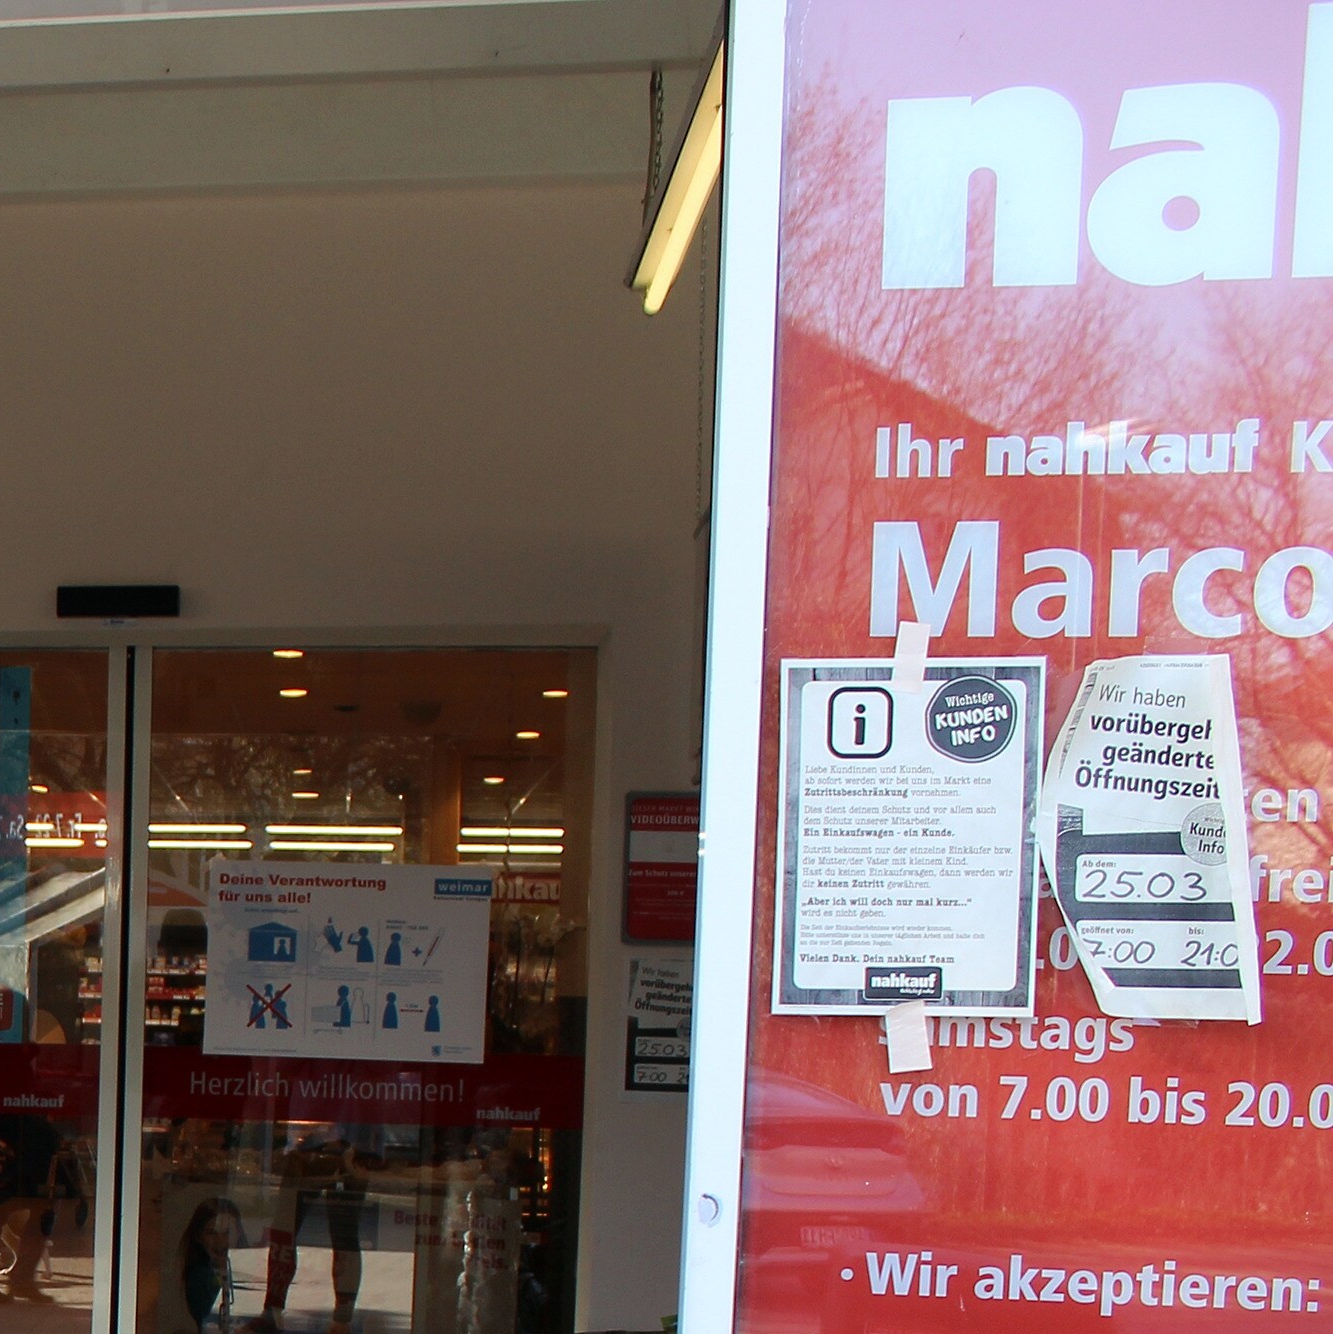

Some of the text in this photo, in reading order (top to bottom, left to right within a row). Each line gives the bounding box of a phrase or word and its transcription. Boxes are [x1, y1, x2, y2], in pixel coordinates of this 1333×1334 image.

[882, 3, 1333, 290] na
[875, 423, 963, 478] Ihr
[986, 418, 1260, 477] nahkauf
[869, 521, 1333, 638] Marco
[944, 692, 995, 708] Wichtige
[1099, 684, 1186, 708] Wir haben
[935, 704, 1008, 730] KUNDEN
[951, 725, 996, 746] INFO
[804, 787, 908, 798] Zutrittsbeschränkung
[803, 828, 820, 837] Ein
[823, 828, 894, 838] Einkaufswagen
[903, 828, 918, 837] ein
[921, 828, 955, 837] Kunde.
[1190, 823, 1226, 838] Kund
[1198, 840, 1224, 855] Info
[1082, 860, 1116, 868] Ab dem:
[219, 873, 387, 892] Deine Verantwortung
[438, 881, 489, 893] weimar
[817, 880, 849, 888] keinen
[851, 880, 884, 888] Zutritt
[1082, 869, 1208, 901] 25.03
[219, 889, 312, 904] für uns alle!
[833, 898, 847, 906] ich
[849, 898, 868, 906] will
[871, 898, 893, 906] doch
[896, 898, 913, 906] nur
[916, 898, 933, 906] mal
[1189, 927, 1205, 935] bis:
[800, 954, 955, 962] Vielen Dank. Dein nahkauf Team
[1083, 938, 1156, 964] 7:00
[871, 972, 937, 989] nahkauf
[190, 1071, 464, 1102] Herzlich willkommen!
[3, 1094, 65, 1108] nahkauf
[880, 1083, 978, 1118] von
[999, 1075, 1110, 1123] 7.00
[1127, 1076, 1206, 1124] bis
[476, 1106, 541, 1121] nahkauf
[866, 1250, 1321, 1317] Wir akzeptieren:
